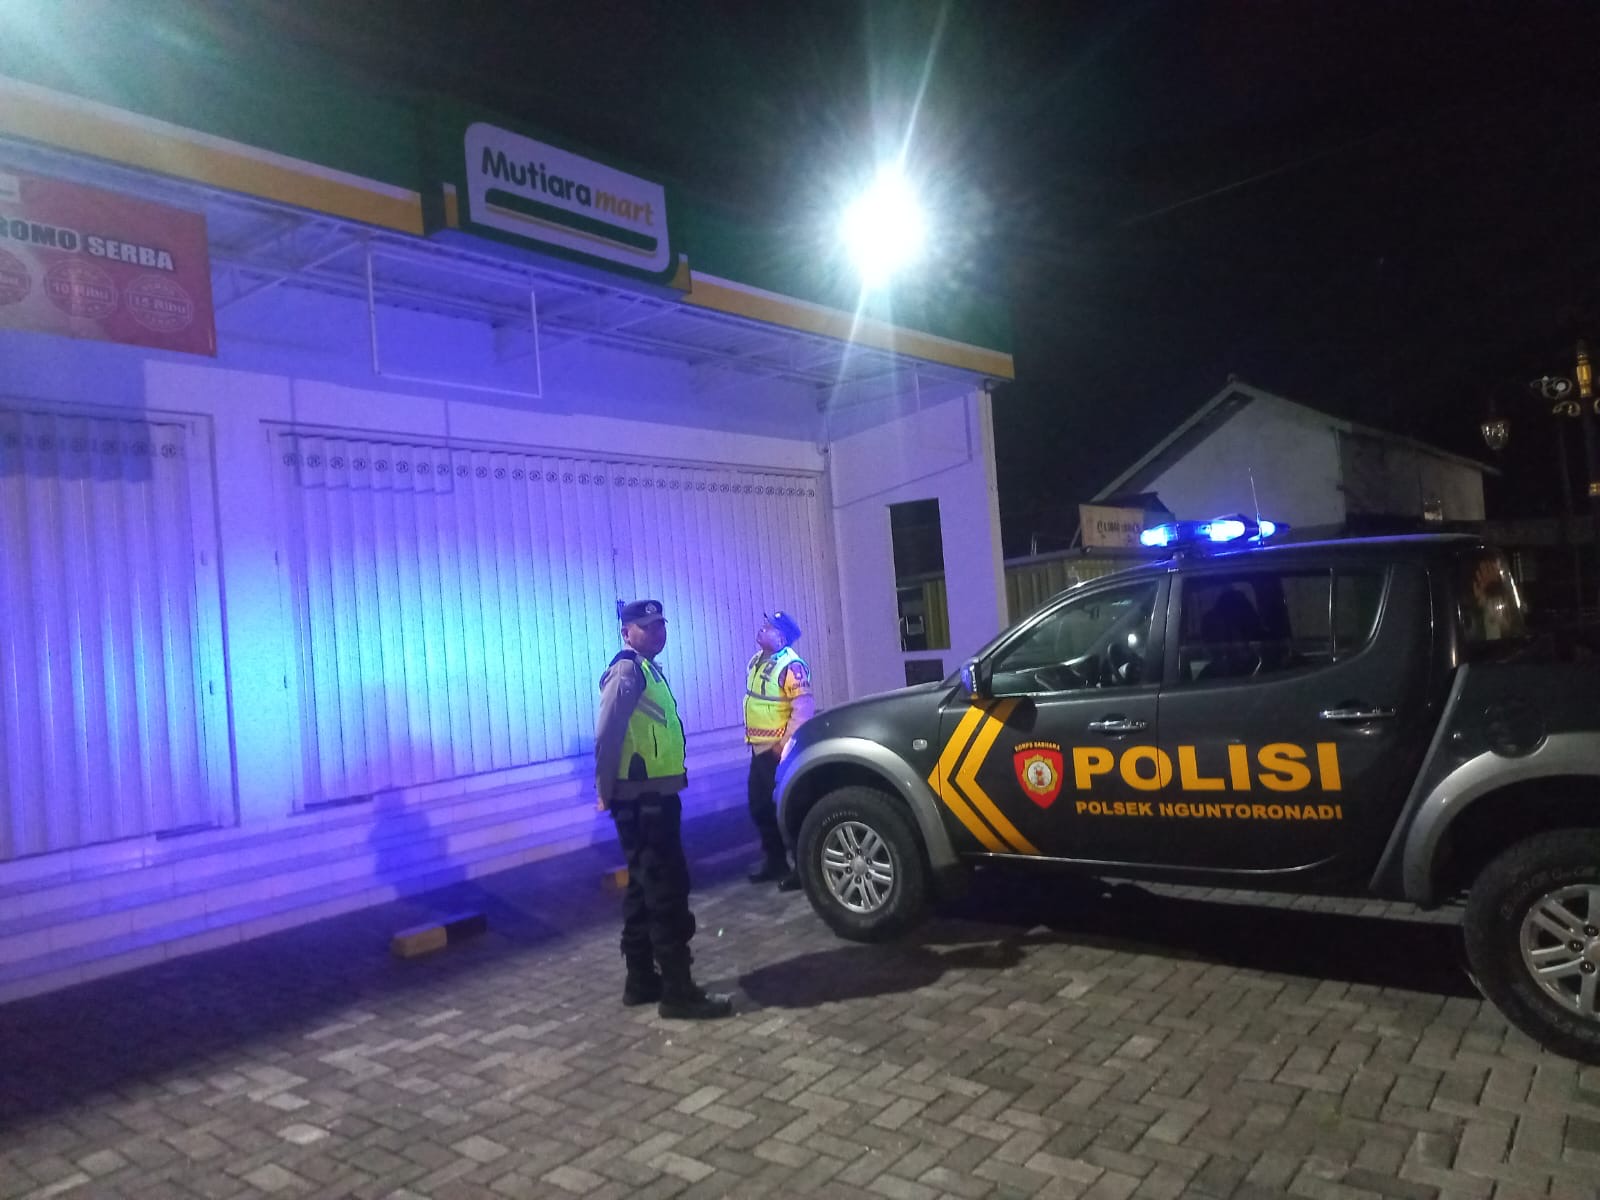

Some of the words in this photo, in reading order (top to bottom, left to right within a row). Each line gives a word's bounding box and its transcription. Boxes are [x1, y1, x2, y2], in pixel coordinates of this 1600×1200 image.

[481, 145, 592, 207] Mutiara
[594, 187, 655, 227] mart
[87, 235, 175, 272] SERBA
[1072, 742, 1342, 792] POLISI
[1076, 801, 1154, 817] POLSEK
[1159, 801, 1343, 820] NGUNTORONADI
